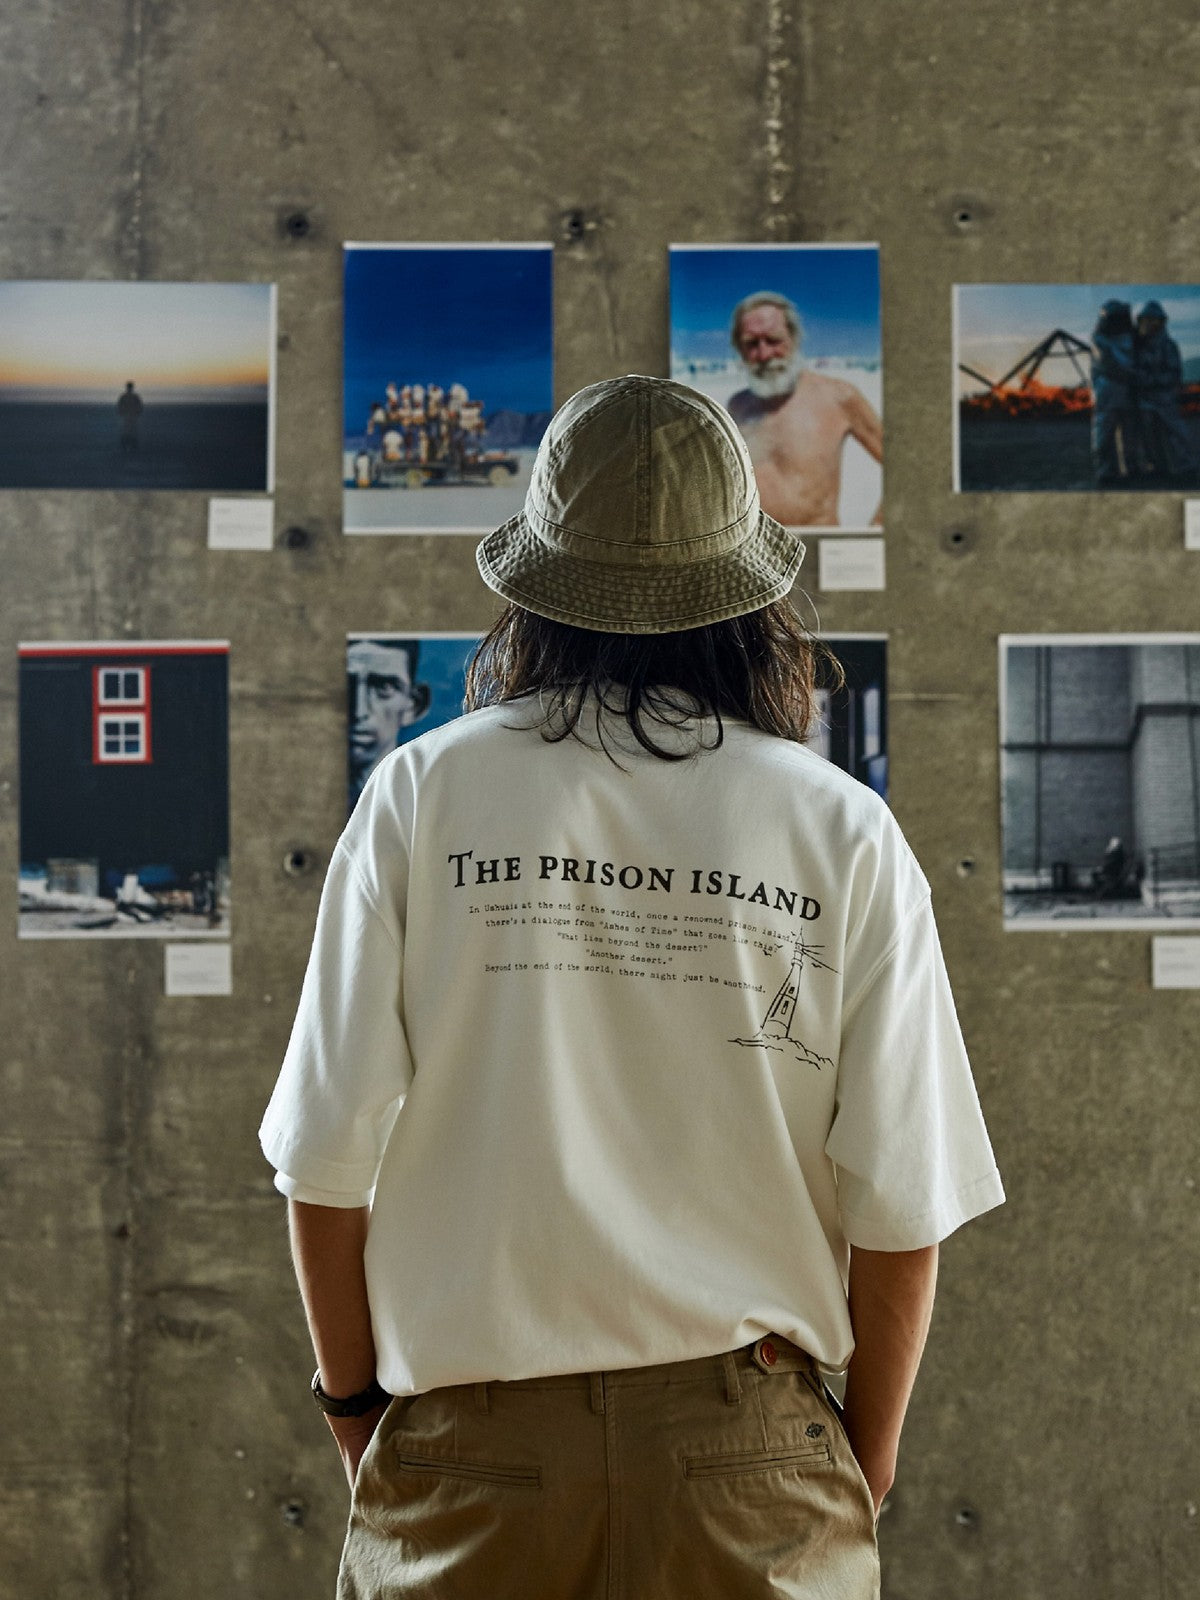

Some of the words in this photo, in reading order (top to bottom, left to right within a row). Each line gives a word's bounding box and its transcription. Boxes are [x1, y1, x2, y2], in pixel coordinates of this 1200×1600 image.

[448, 850, 521, 888] THE
[538, 855, 675, 893] PRISON
[690, 869, 822, 921] ISLAND
[538, 901, 553, 909] the
[590, 906, 605, 914] the
[646, 912, 668, 921] once
[684, 916, 723, 925] renowned
[728, 919, 757, 932] prison
[485, 918, 517, 927] there's
[531, 917, 571, 926] dialogue
[575, 918, 595, 927] from
[600, 921, 630, 932] "Ashes
[635, 926, 645, 934] of
[651, 927, 678, 936] Time"
[683, 930, 703, 938] that
[708, 933, 727, 941] goes
[583, 934, 603, 943] lies
[608, 938, 639, 946] beyond
[665, 943, 708, 952] desert?"
[586, 949, 625, 960] "Another
[630, 955, 673, 965] desert."
[485, 964, 511, 973] Beyond
[533, 962, 550, 970] end
[554, 963, 563, 971] of
[619, 969, 645, 977] there
[683, 974, 703, 982] just
[709, 975, 719, 983] be
